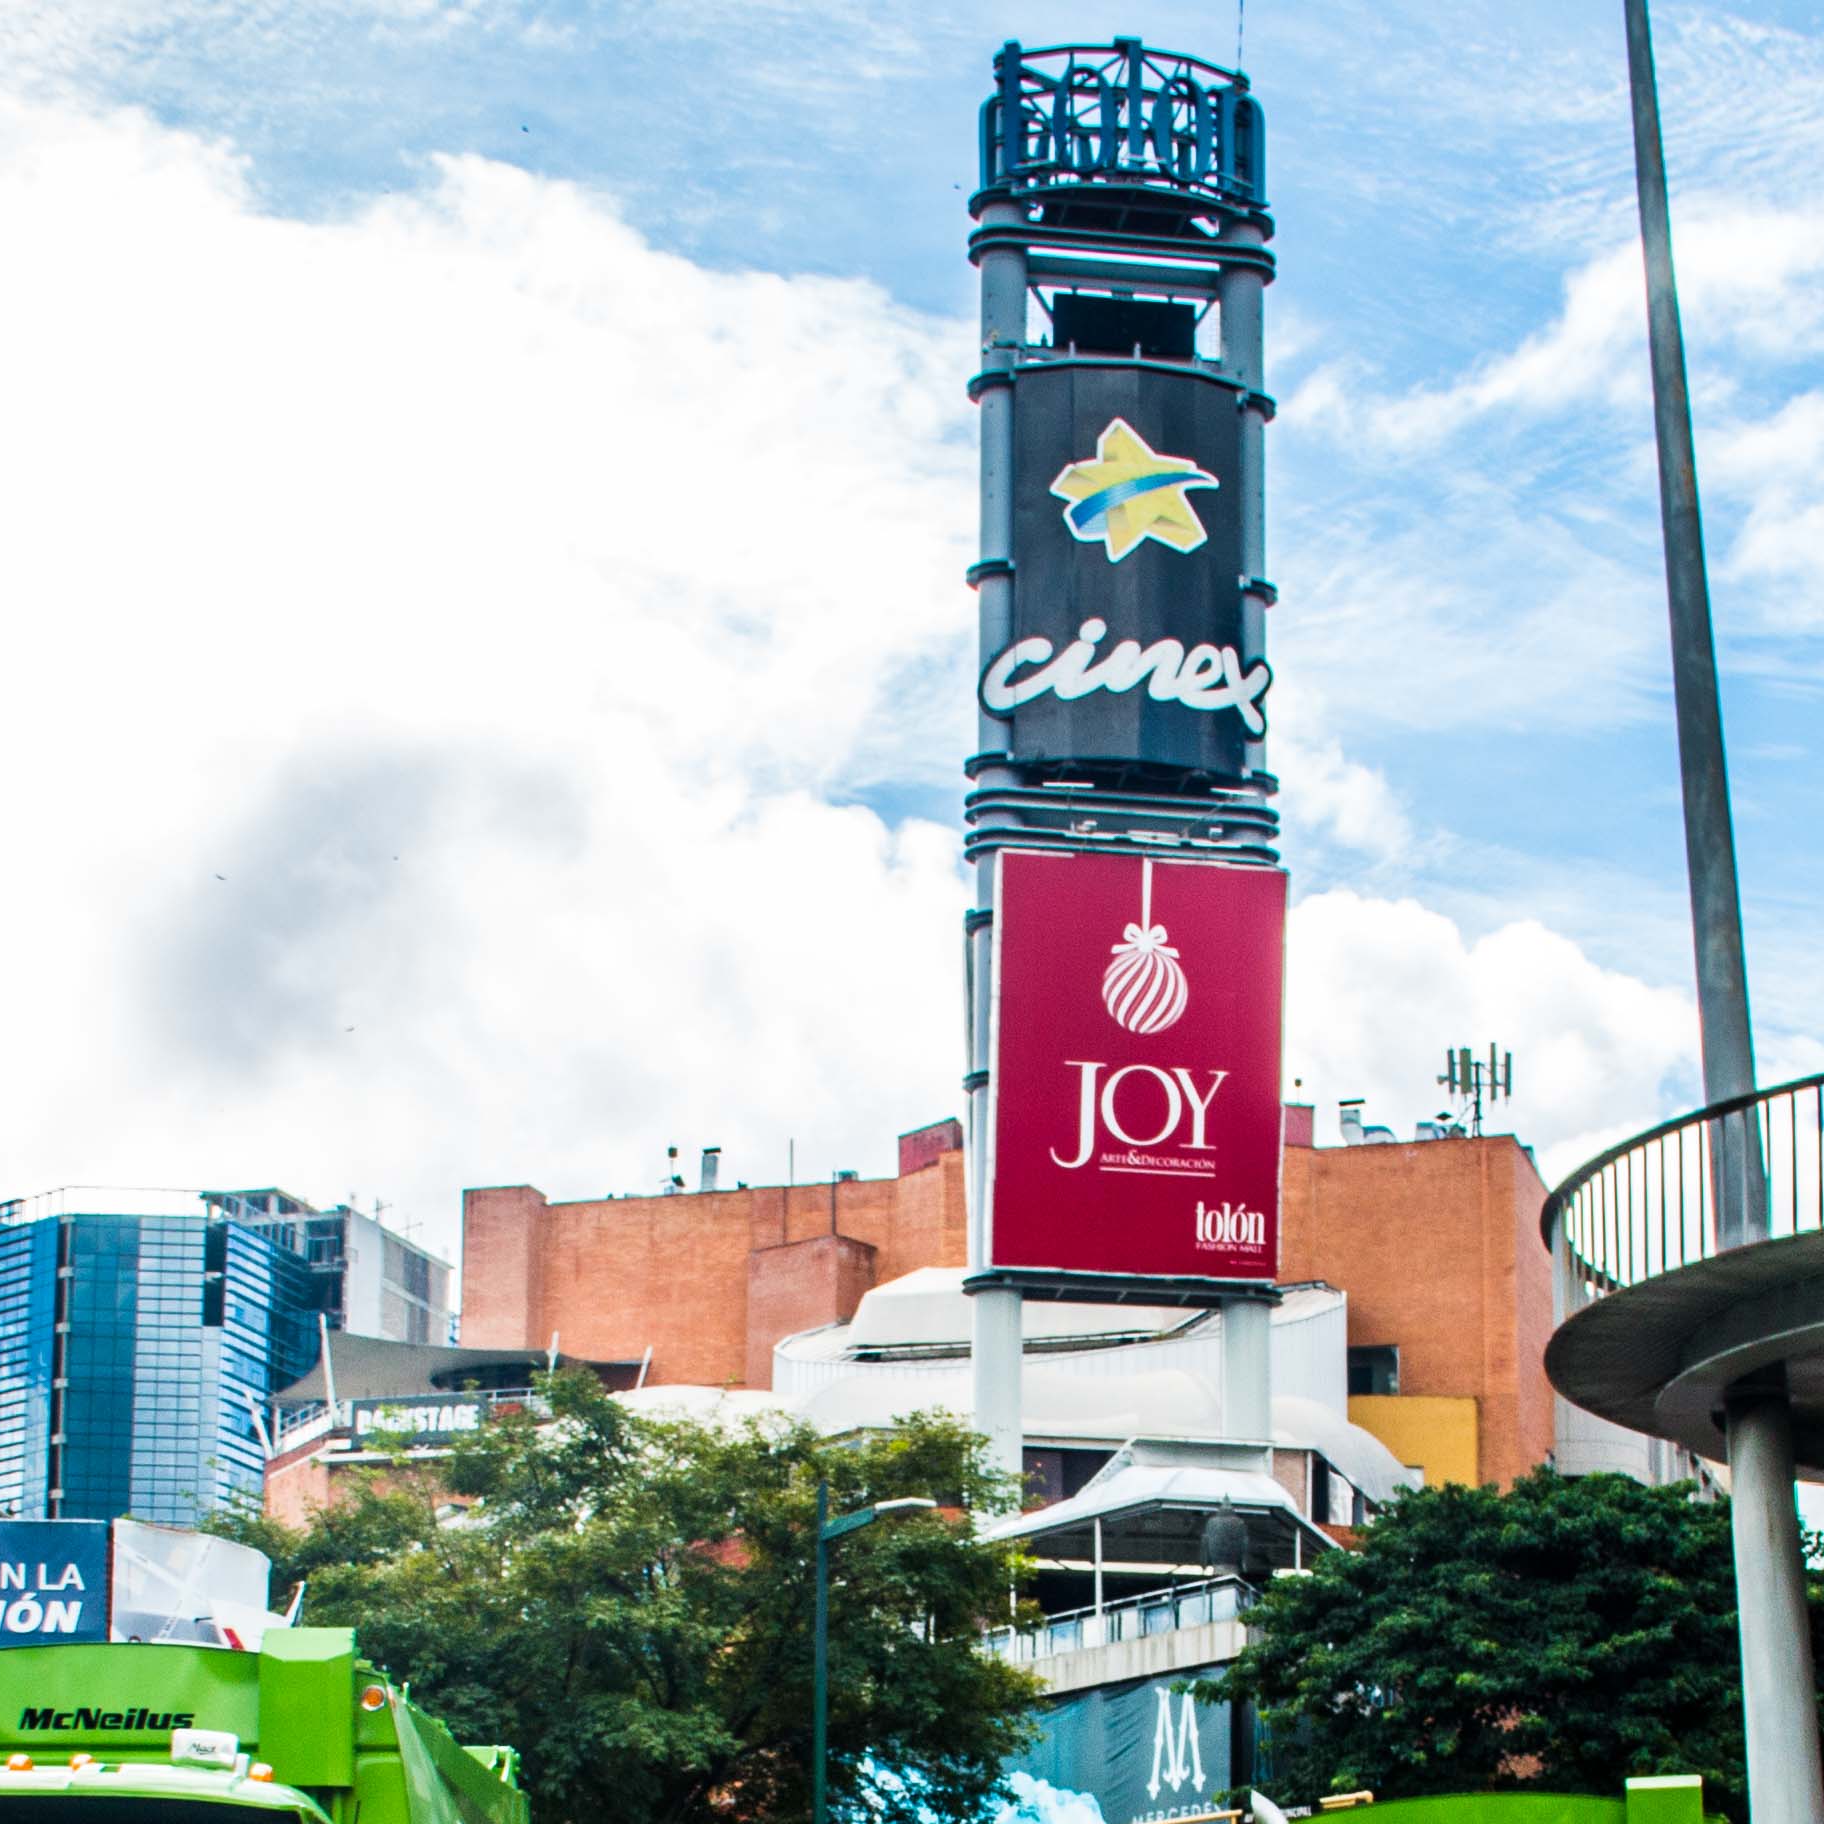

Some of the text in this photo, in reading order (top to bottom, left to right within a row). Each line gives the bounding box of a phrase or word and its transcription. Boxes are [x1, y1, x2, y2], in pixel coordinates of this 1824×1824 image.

[982, 617, 1271, 735] cinex
[1049, 1059, 1230, 1169] JOY
[1194, 1200, 1267, 1245] tolón
[37, 1563, 86, 1591] LA
[19, 1707, 195, 1730] McNeilus
